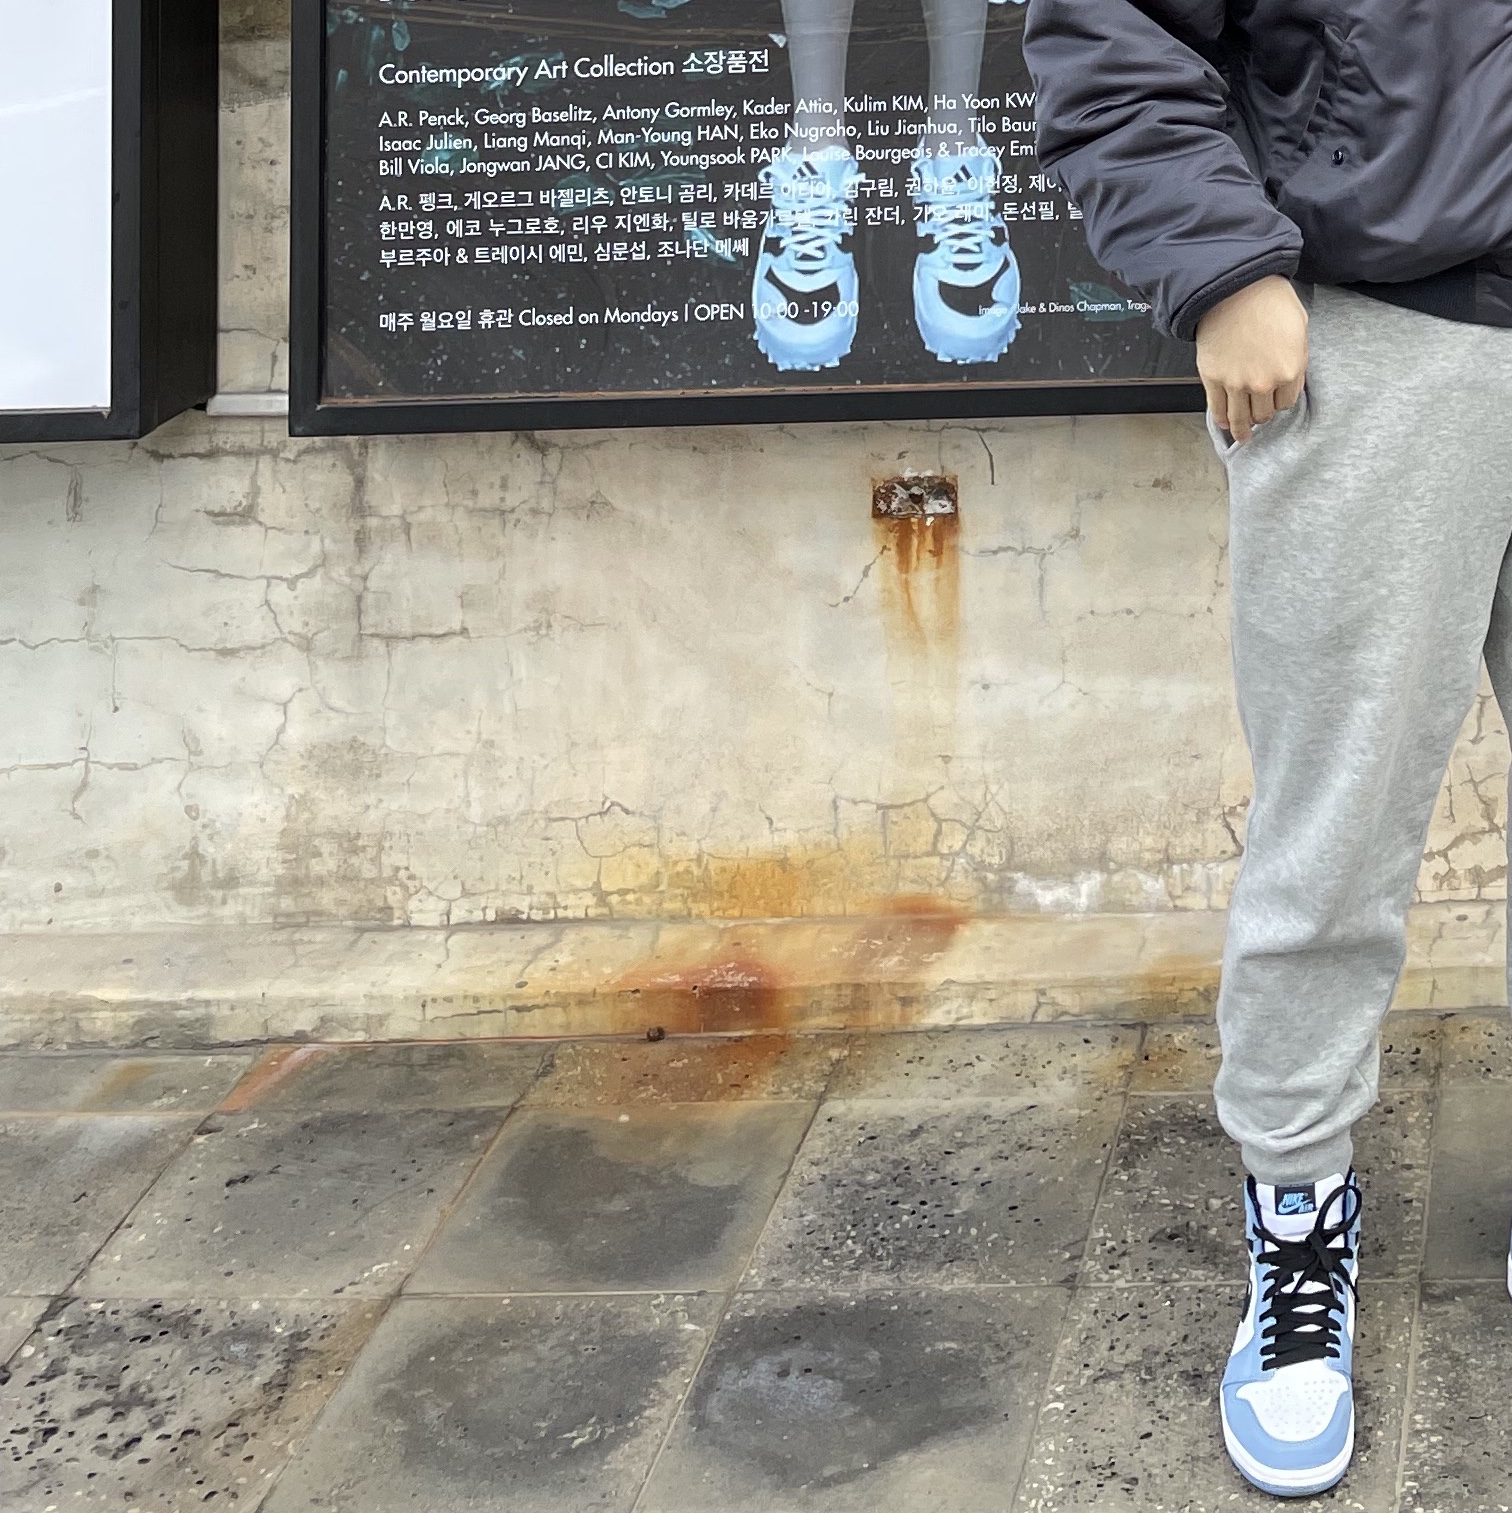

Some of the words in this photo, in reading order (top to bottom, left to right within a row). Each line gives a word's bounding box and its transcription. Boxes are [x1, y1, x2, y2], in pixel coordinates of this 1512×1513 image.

[378, 62, 530, 89] Contemporary
[534, 58, 568, 81] Art
[574, 54, 675, 79] Collection
[681, 49, 770, 76] 소장품전
[378, 110, 413, 129] A.R.
[419, 108, 470, 129] Penck,
[474, 108, 527, 129] Georg
[532, 105, 598, 125] Baselitz,
[602, 104, 661, 125] Antony
[665, 99, 739, 120] Gormley,
[743, 97, 791, 116] Kader
[795, 98, 838, 116] Attia,
[844, 94, 887, 113] Kulim
[892, 95, 929, 113] KIM,
[934, 95, 957, 111] Ha
[962, 93, 1000, 110] Yoon
[1005, 92, 1037, 109] KW
[378, 135, 422, 153] Isaac
[426, 133, 478, 152] Julien,
[484, 132, 528, 154] Liang
[533, 130, 593, 150] Manqi,
[597, 128, 692, 149] Man-Young
[697, 125, 744, 144] HAN,
[750, 121, 779, 140] Eko
[784, 119, 862, 143] Nugroho,
[868, 119, 890, 137] Liu
[894, 117, 963, 136] Jianhua,
[968, 115, 997, 133] Tilo
[378, 159, 402, 177] Bill
[407, 158, 454, 177] Viola,
[459, 158, 531, 179] Jongwan
[535, 154, 591, 173] JANG,
[596, 153, 614, 169] CI
[619, 152, 655, 171] KIM,
[660, 147, 746, 169] Youngsook
[750, 146, 797, 164] PARK,
[803, 146, 851, 162] Louise
[855, 141, 933, 165] Bourgeois
[937, 141, 951, 158] &
[955, 140, 1006, 159] Tracey
[1010, 139, 1038, 156] Emi
[378, 193, 413, 212] A.R.
[418, 192, 459, 212] 펭크,
[464, 190, 535, 211] 게오르그
[539, 187, 614, 209] 바젤리츠,
[619, 185, 673, 207] 안토니
[678, 184, 718, 204] 곰리,
[724, 181, 774, 202] 카데르
[844, 178, 900, 199] 김구림,
[379, 220, 440, 241] 한만영,
[446, 219, 482, 239] 에코
[488, 216, 565, 238] 누그로호,
[572, 214, 609, 237] 리우
[614, 212, 674, 233] 지엔화,
[681, 211, 717, 230] 틸로
[864, 205, 906, 226] 잔더,
[1002, 200, 1060, 221] 돈선필,
[379, 247, 451, 268] 부르주아
[455, 248, 469, 264] &
[474, 244, 543, 265] 트레이시
[549, 242, 588, 264] 에민,
[594, 240, 651, 262] 심문섭,
[657, 238, 710, 260] 조나단
[715, 236, 750, 258] 메쎄
[379, 312, 415, 333] 매주
[420, 309, 473, 332] 월요일
[478, 309, 514, 330] 휴관
[518, 307, 574, 329] Closed
[578, 310, 599, 326] on
[604, 306, 679, 329] Mondays
[694, 303, 745, 322] OPEN
[1039, 302, 1047, 314] &
[1049, 301, 1075, 314] Dinos
[1076, 299, 1125, 315] Chapman,
[1281, 1192, 1305, 1207] NIKE
